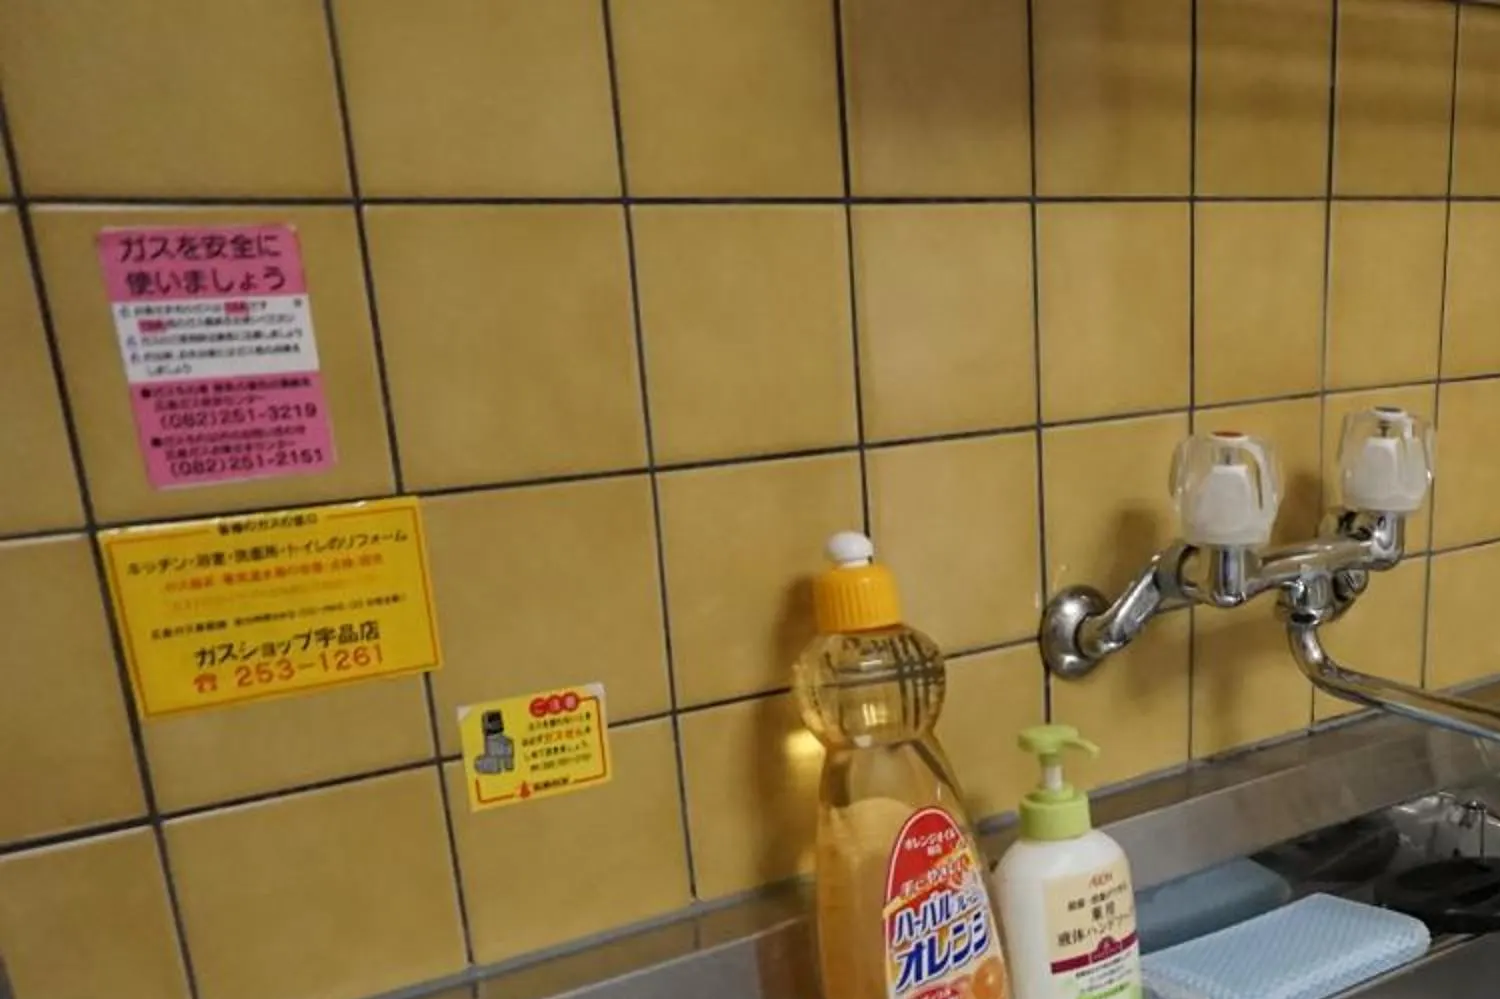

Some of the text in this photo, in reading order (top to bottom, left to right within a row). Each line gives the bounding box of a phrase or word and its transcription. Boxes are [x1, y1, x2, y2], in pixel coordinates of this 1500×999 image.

[119, 233, 282, 262] ガスを安全に
[126, 266, 286, 295] 使いましょう
[195, 620, 381, 667] ガスショップ宇品店
[235, 645, 384, 689] 253-1261
[894, 887, 951, 945] ハーバル
[895, 910, 988, 992] オレンジ
